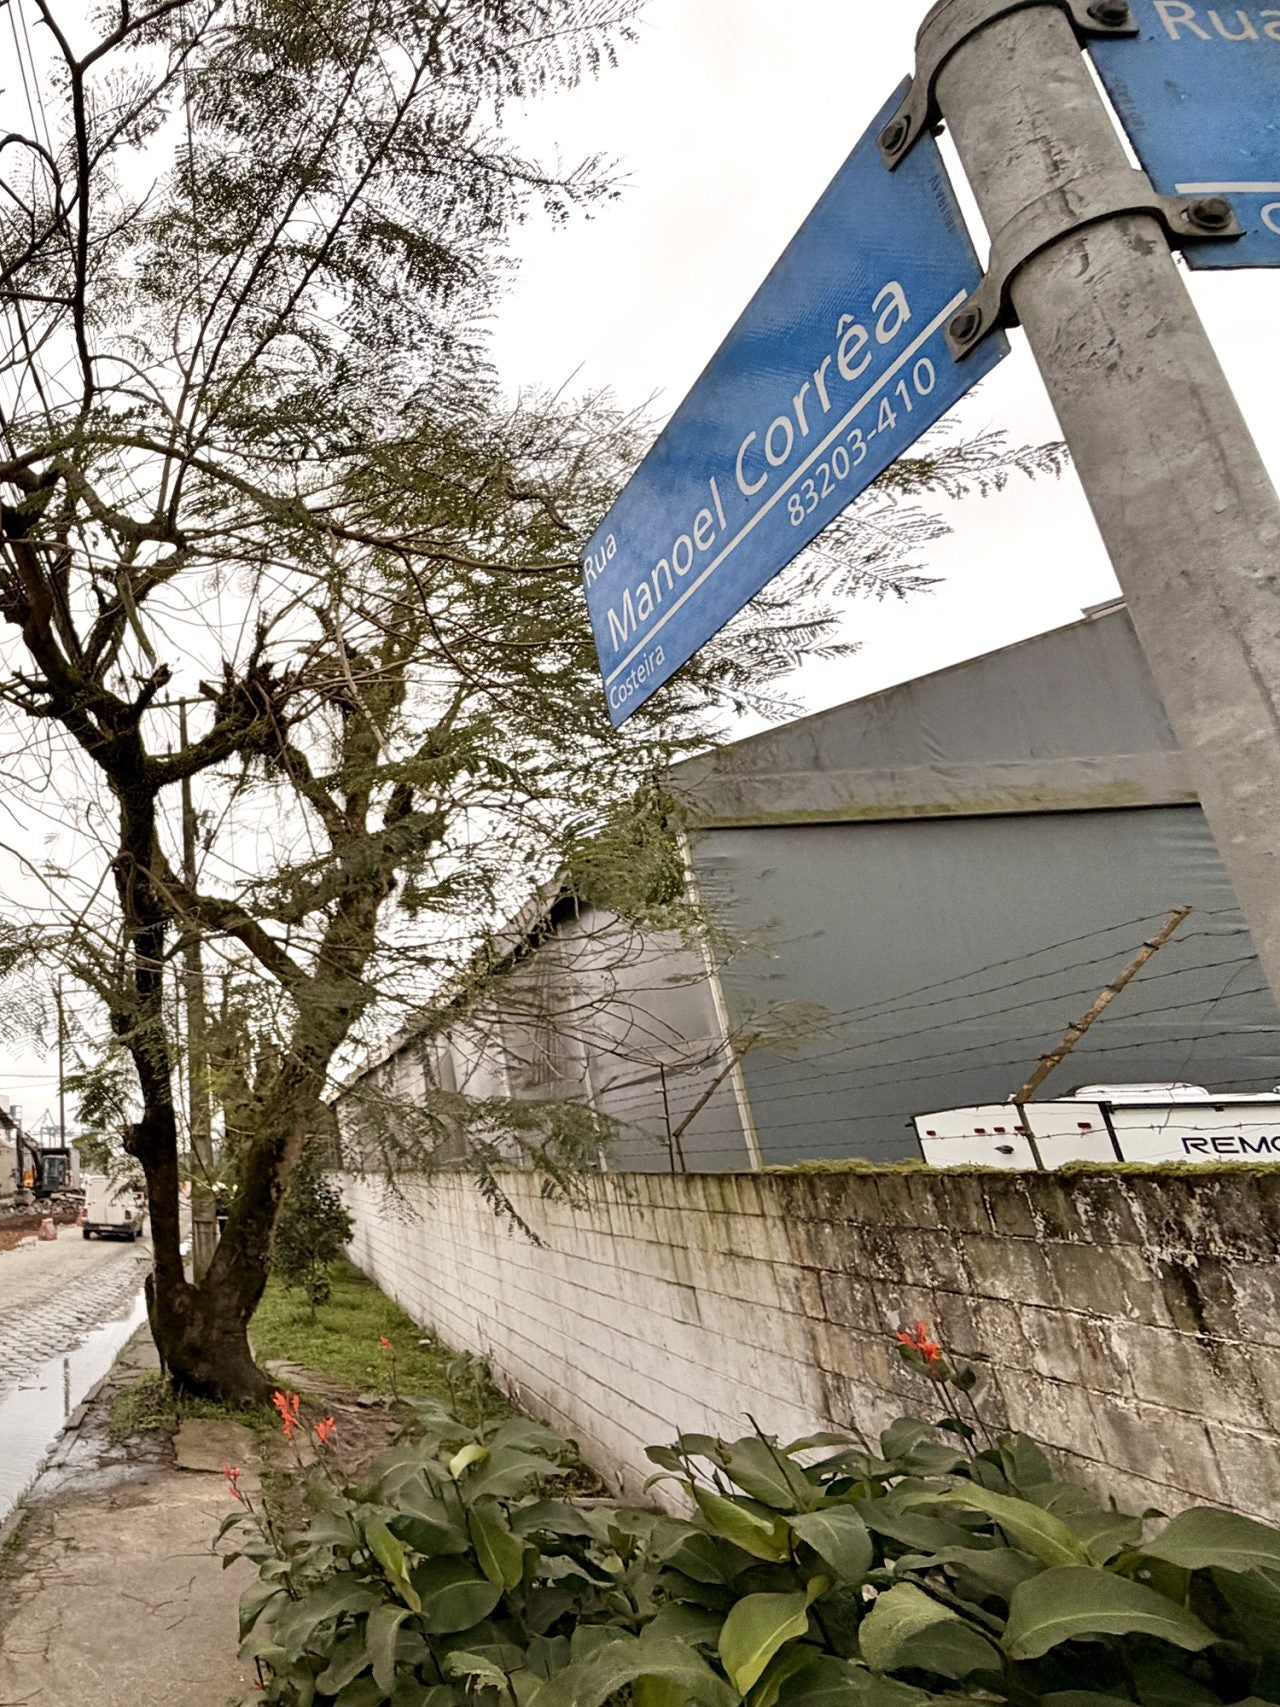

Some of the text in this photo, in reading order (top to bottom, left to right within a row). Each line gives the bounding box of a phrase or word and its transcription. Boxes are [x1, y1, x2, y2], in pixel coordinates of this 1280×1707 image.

[606, 280, 912, 653] Manoel Corrêa
[787, 357, 936, 528] 83203-410
[583, 533, 618, 589] Rua
[609, 644, 666, 710] Costeira
